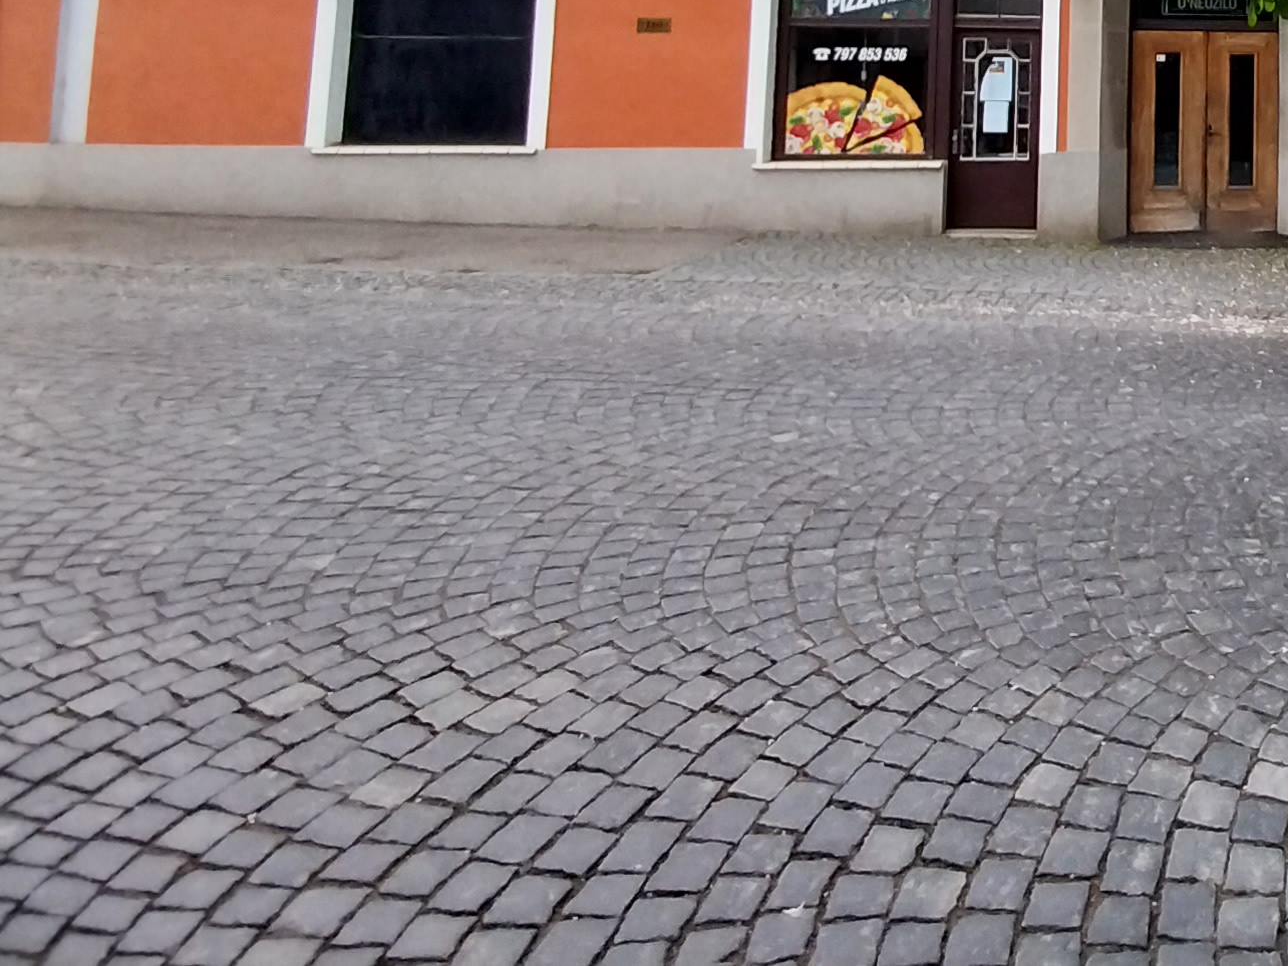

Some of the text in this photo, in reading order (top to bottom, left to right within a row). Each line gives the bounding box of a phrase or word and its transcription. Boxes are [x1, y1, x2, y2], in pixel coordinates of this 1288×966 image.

[833, 46, 908, 62] 797 853 536
